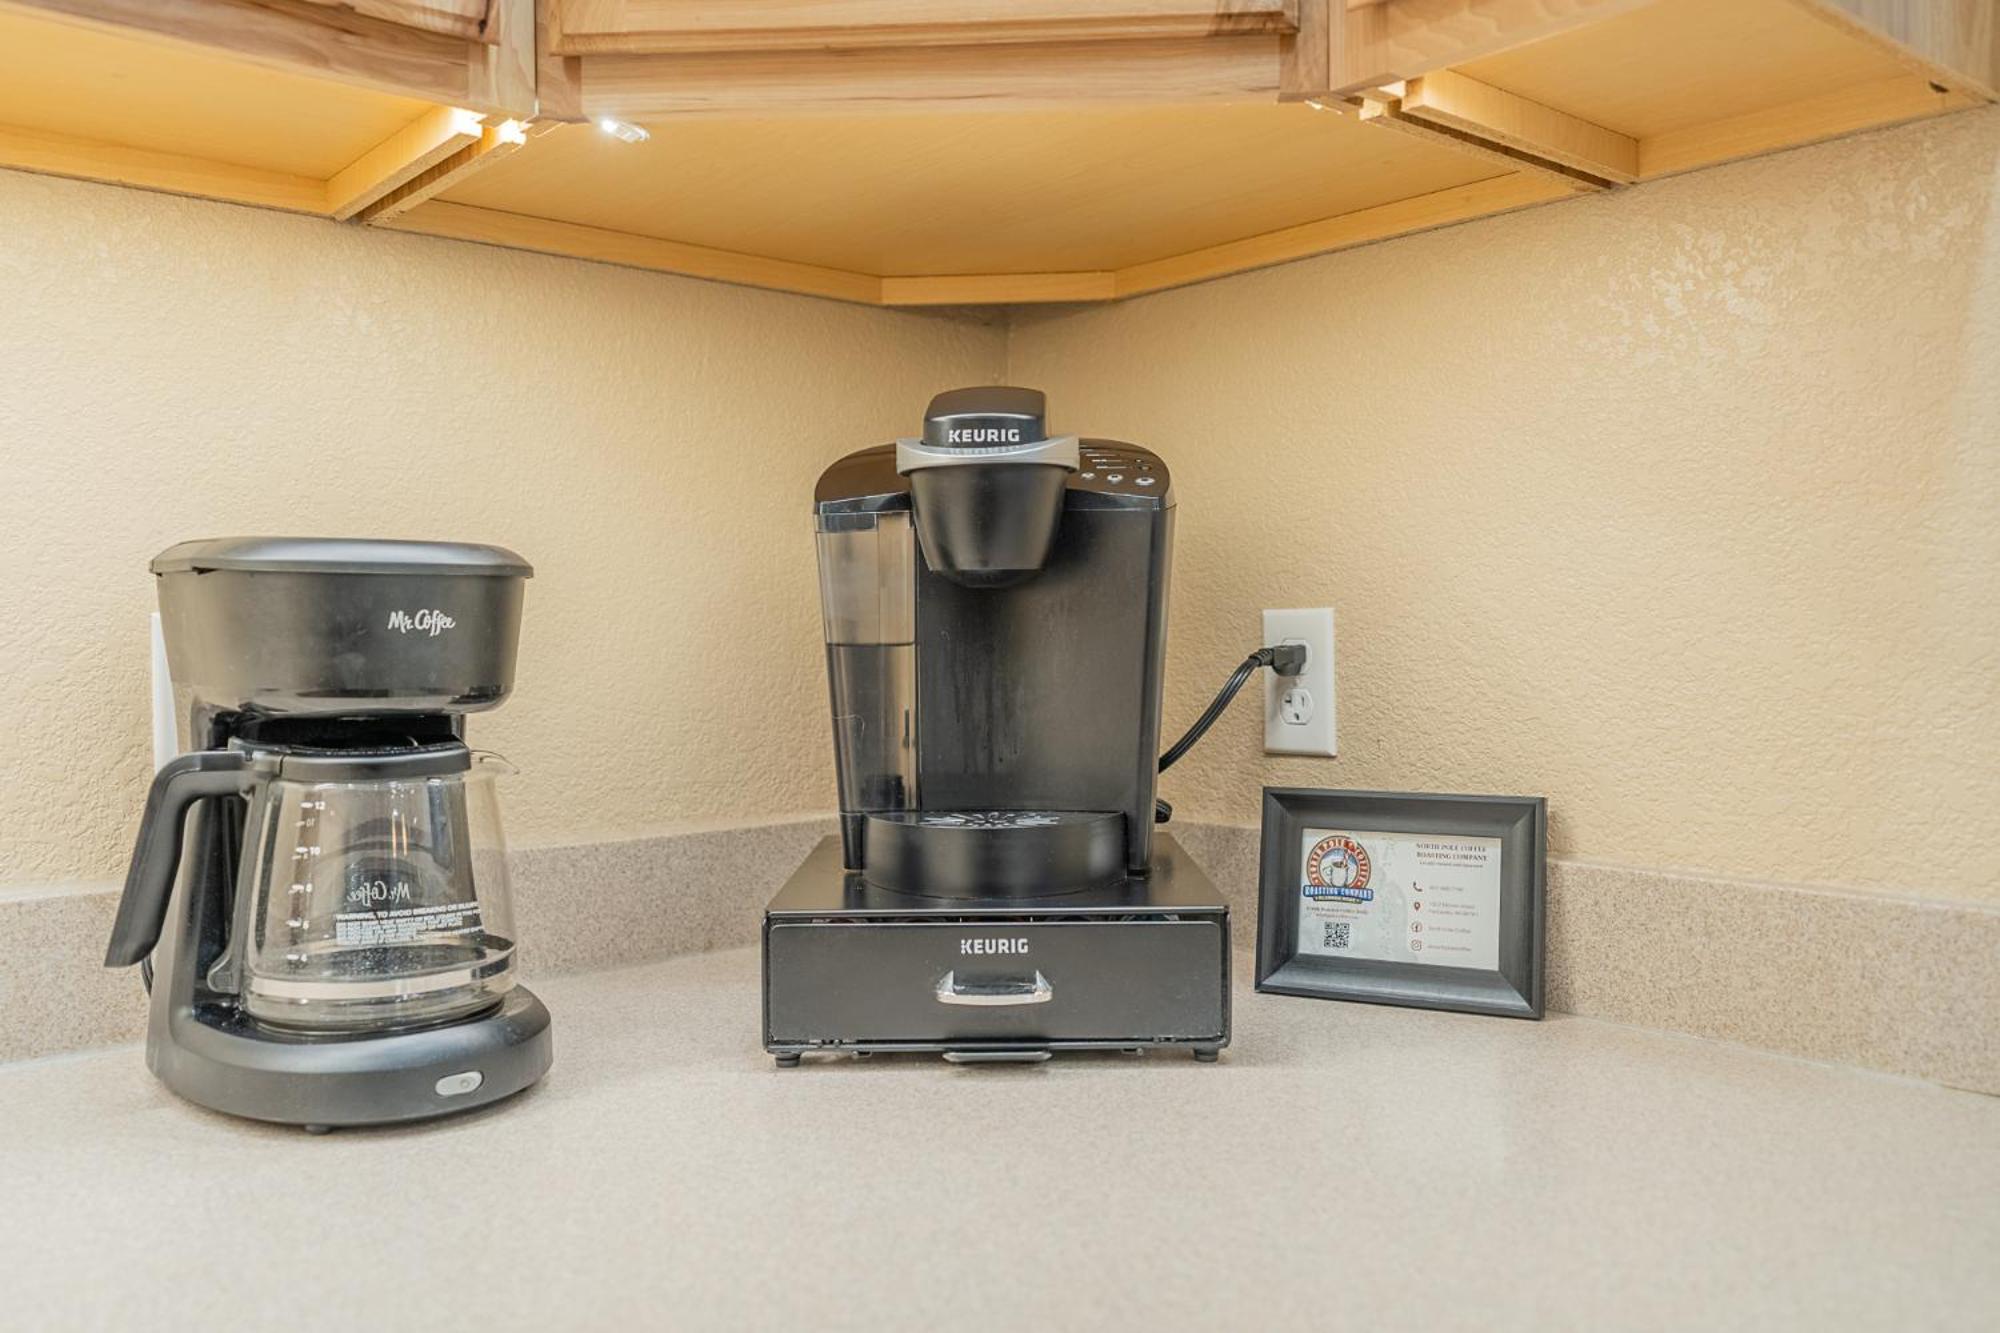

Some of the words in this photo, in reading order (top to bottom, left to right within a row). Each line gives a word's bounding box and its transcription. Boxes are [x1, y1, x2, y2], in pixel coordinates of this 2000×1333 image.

[948, 429, 1020, 443] KEURIG
[387, 610, 414, 634] Mr.
[414, 608, 457, 637] Coffee
[314, 800, 326, 811] 12
[960, 938, 1029, 955] KEURIG
